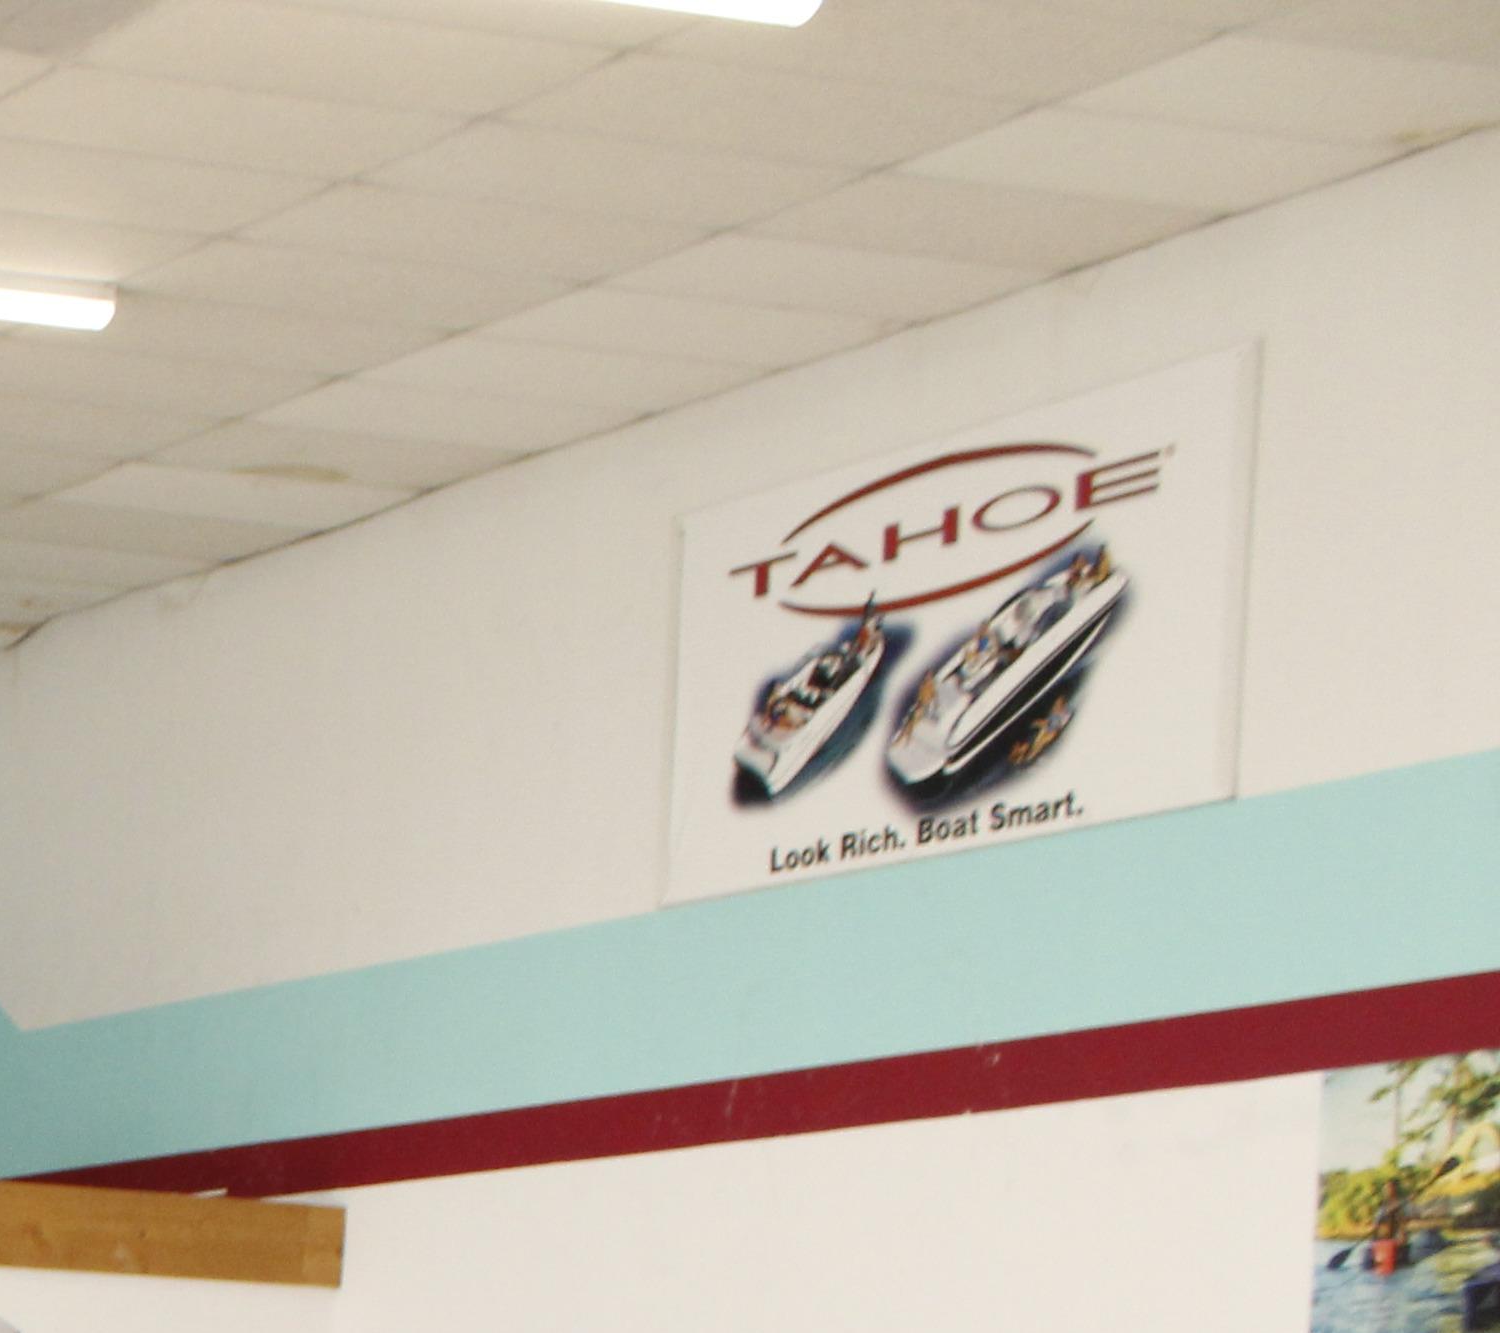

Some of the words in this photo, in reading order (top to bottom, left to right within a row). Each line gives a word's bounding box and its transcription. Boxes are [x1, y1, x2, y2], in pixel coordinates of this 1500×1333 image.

[729, 450, 1160, 597] TAHOE
[770, 834, 830, 874] Look
[840, 821, 905, 861] Rich.
[918, 811, 978, 845] Boat
[990, 792, 1083, 831] Smart.
